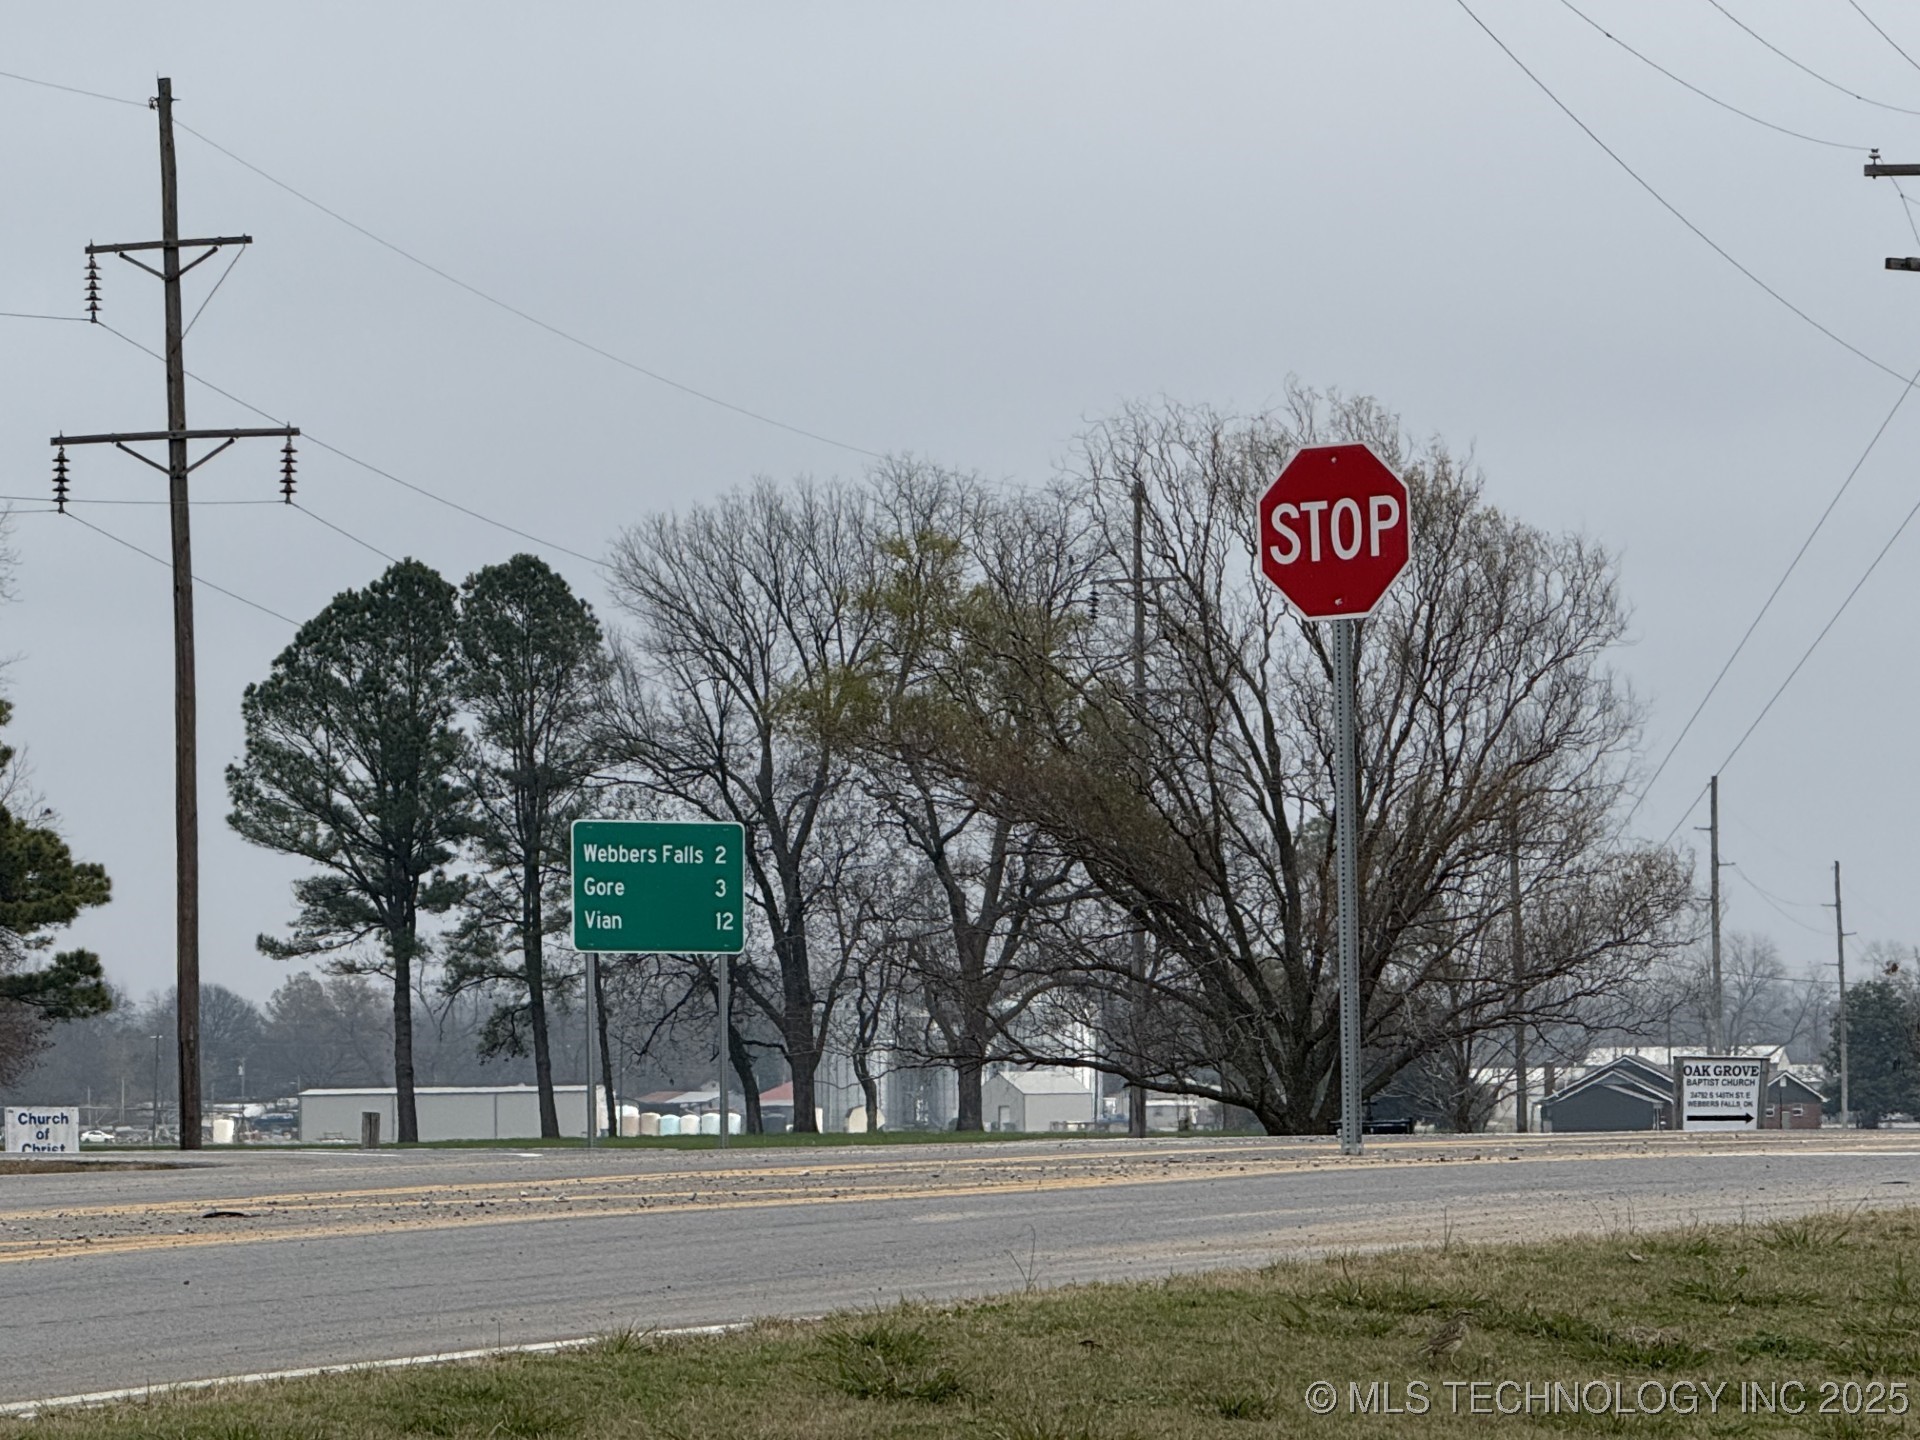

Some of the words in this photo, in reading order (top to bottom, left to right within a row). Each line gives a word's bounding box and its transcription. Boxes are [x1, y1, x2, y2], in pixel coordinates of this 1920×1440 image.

[1269, 495, 1400, 565] STOP
[583, 844, 657, 863] Webbers
[662, 845, 704, 864] Falls
[715, 846, 727, 864] 2
[584, 877, 625, 896] Gore
[715, 879, 726, 897] 3
[584, 910, 622, 929] Vian
[715, 912, 734, 930] 12
[1683, 1065, 1711, 1077] OAK
[1713, 1065, 1759, 1077] GROVE
[1686, 1078, 1719, 1086] BAPTIST
[1721, 1078, 1756, 1086] CHURCH
[18, 1112, 69, 1125] Church
[36, 1127, 50, 1140] of
